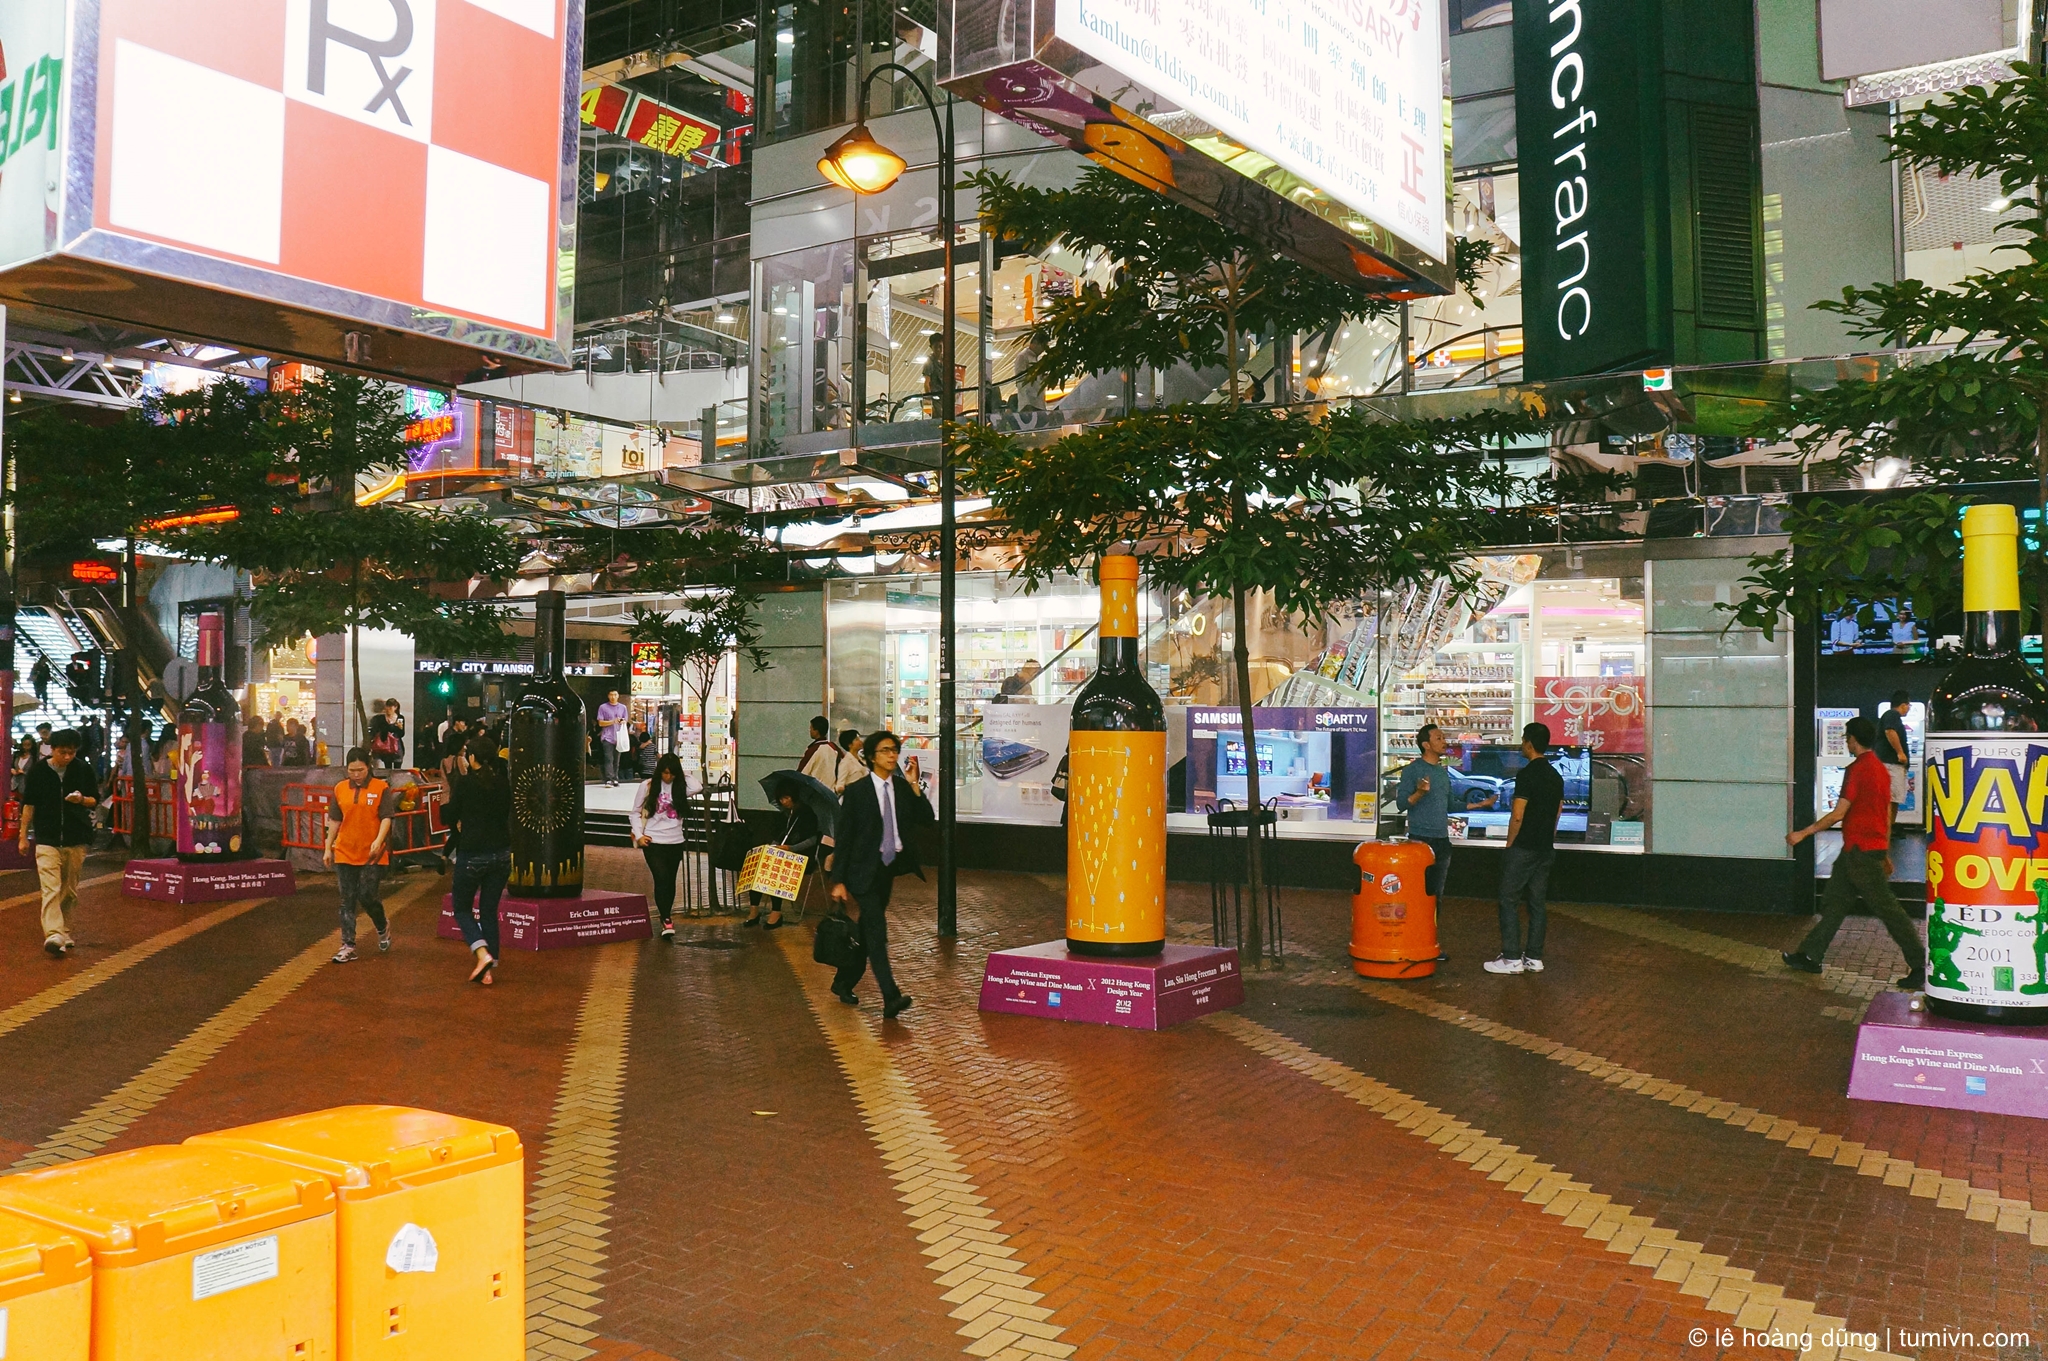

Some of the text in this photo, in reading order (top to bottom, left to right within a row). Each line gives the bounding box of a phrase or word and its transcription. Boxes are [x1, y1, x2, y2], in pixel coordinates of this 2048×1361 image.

[1332, 0, 1403, 58] NSARY
[1358, 38, 1372, 57] LTD
[1079, 0, 1249, 123] kamlun@kldisp.com.hk
[640, 113, 707, 162] 惠康
[1400, 132, 1426, 204] 正
[462, 663, 487, 672] CITY
[493, 664, 534, 673] MANSIO
[989, 719, 1011, 727] designed
[1194, 712, 1243, 724] SAMSUN
[1355, 714, 1368, 724] TV
[764, 855, 803, 871] 手提電話
[767, 848, 804, 863] 高價回收
[762, 862, 800, 878] 數碼相機
[757, 877, 796, 892] NDS PSP
[1966, 946, 2011, 962] 2001
[1010, 969, 1060, 980] American Express
[1176, 975, 1184, 984] Siu
[1184, 973, 1197, 982] Hong
[1198, 969, 1217, 979] Freeman
[988, 976, 1003, 984] Hong
[1004, 977, 1019, 986] Kong
[1063, 983, 1083, 991] Month
[1087, 978, 1096, 990] X
[1116, 980, 1133, 988] Hong
[1134, 981, 1150, 990] Kong
[1107, 988, 1128, 997] Design
[1899, 1045, 1983, 1060] American Express
[1861, 1052, 2023, 1075] Hong Kong Wine and Dine Month
[2030, 1059, 2045, 1074] X
[245, 1241, 266, 1250] NOTICE
